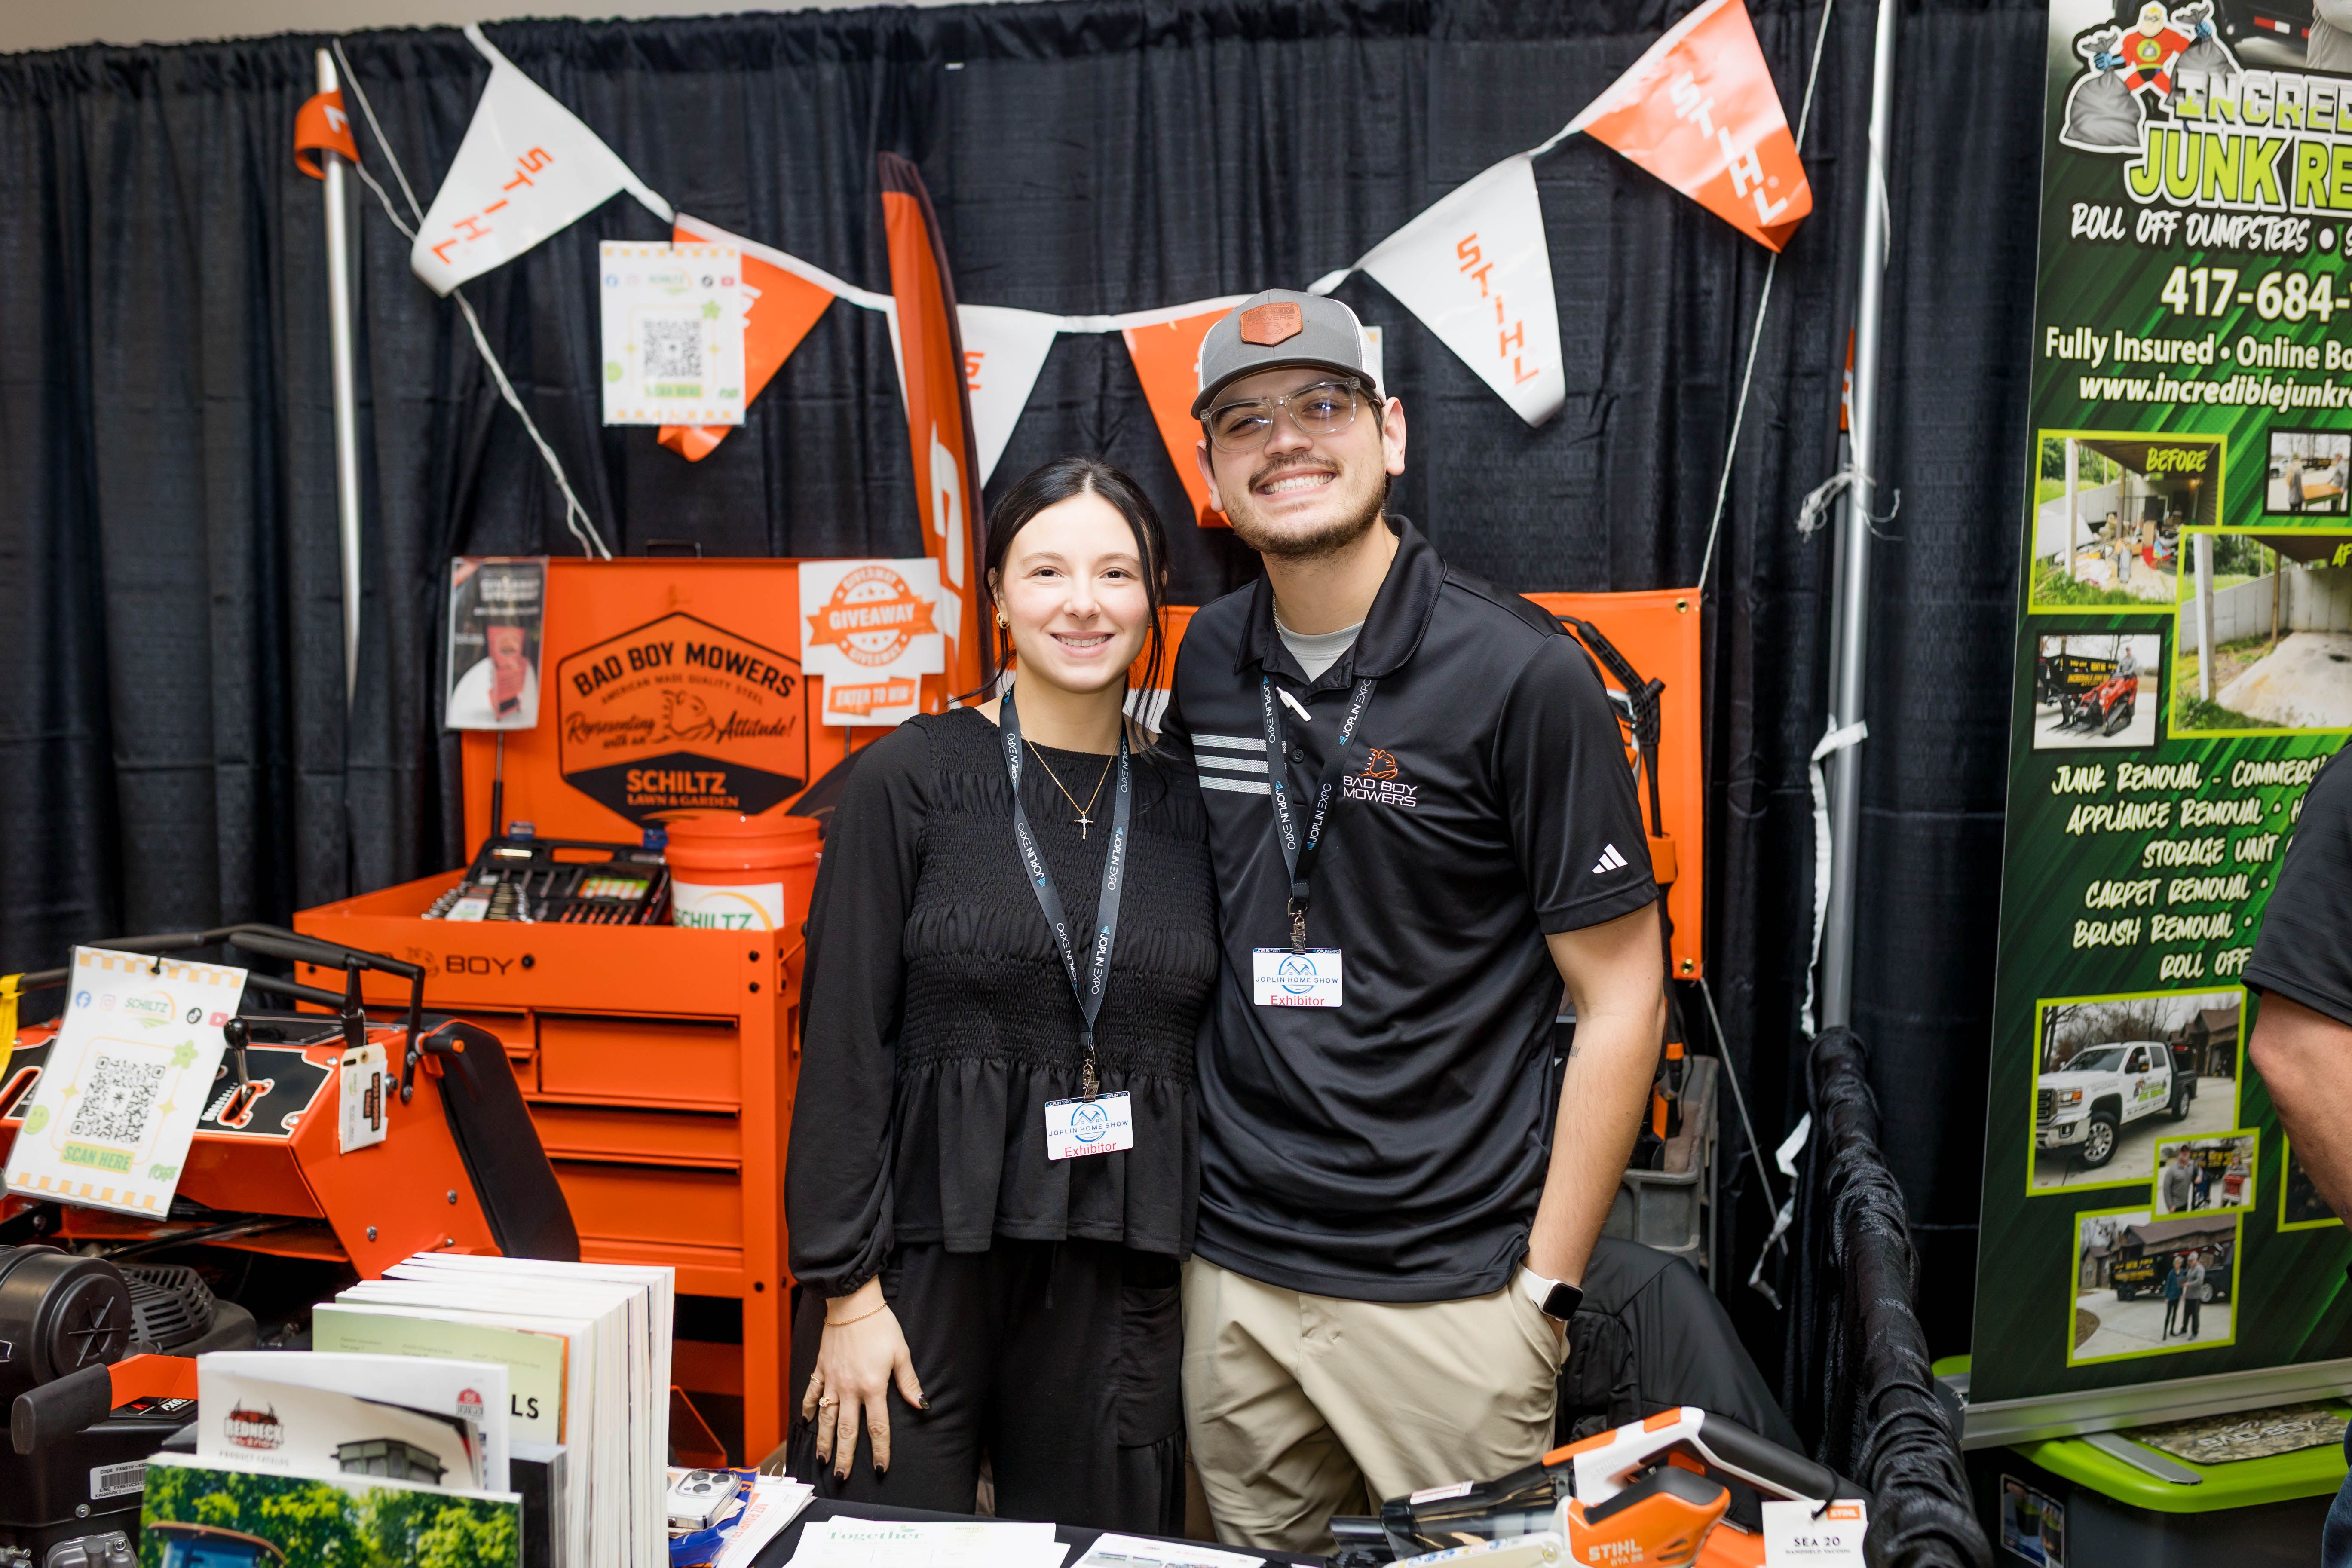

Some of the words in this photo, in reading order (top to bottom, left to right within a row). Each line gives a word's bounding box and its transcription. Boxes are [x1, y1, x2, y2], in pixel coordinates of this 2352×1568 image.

[1668, 72, 1788, 226] STIHL
[2129, 128, 2287, 205] JUNK
[430, 147, 555, 265] STIHL
[2071, 202, 2126, 240] ROLL
[2136, 209, 2183, 245] OFF
[2186, 213, 2310, 252] DUMPSTERS
[2161, 266, 2352, 322] 417-684-
[1246, 310, 1267, 321] BAD
[1247, 315, 1294, 327] MOWERS
[1456, 233, 1539, 386] STIHL
[2046, 326, 2108, 368] Fully
[2114, 330, 2214, 365] Insured
[2236, 336, 2320, 369] Online
[2146, 447, 2208, 472] BEFORE
[829, 603, 915, 630] GIVEAWAY
[573, 655, 623, 698] BAD
[627, 641, 674, 672] BOY
[685, 642, 796, 698] MOWERS
[601, 678, 651, 705] AMERICAN
[655, 673, 684, 684] MADE
[688, 674, 732, 689] QUALITY
[836, 689, 871, 707] ENTER
[873, 688, 886, 704] TO
[1263, 685, 1273, 717] JOPLIN
[1342, 704, 1362, 738] JOPLIN
[1356, 678, 1372, 704] EXPO
[715, 710, 796, 745] Attitude!
[1266, 717, 1276, 744] EXPO
[1007, 733, 1017, 754] EXPO
[626, 769, 726, 795] SCHILTZ
[1008, 754, 1018, 785] JOPLIN
[2052, 765, 2106, 795] JUNK
[2117, 761, 2202, 792] REMOVAL
[1343, 775, 1375, 789] BAD
[1381, 780, 1418, 796] BOY
[1344, 787, 1417, 808] MOWERS
[627, 794, 666, 806] LAWN
[680, 796, 739, 808] GARDEN
[1309, 810, 1325, 843] JOPLIN
[1317, 783, 1332, 811] EXPO
[2180, 797, 2264, 828] REMOVAL
[1275, 790, 1290, 823] JOPLIN
[1283, 824, 1296, 850] EXPO
[1018, 822, 1032, 848] EXPO
[1026, 846, 1045, 878] JOPLIN
[1112, 834, 1122, 865] JOPLIN
[2142, 837, 2226, 869] STORAGE
[1107, 865, 1118, 890] EXPO
[2085, 878, 2162, 909] CARPET
[2168, 874, 2251, 906] REMOVAL
[1057, 923, 1070, 949] EXPO
[2073, 916, 2141, 948] BRUSH
[2151, 912, 2234, 943] REMOVAL
[1095, 933, 1109, 967] JOPLIN
[446, 955, 514, 975] BOY
[1066, 950, 1077, 983] JOPLIN
[2160, 952, 2205, 981] ROLL
[2214, 947, 2253, 976] OFF
[1091, 968, 1103, 995] EXPO
[125, 997, 168, 1013] SCHILTZ
[1271, 995, 1325, 1006] Exhibitor
[1049, 1127, 1077, 1136] JOPLIN
[1106, 1120, 1129, 1128] SHOW
[63, 1145, 96, 1162] SCAN
[98, 1152, 132, 1172] HERE
[1065, 1142, 1117, 1157] Exhibitor
[226, 1418, 282, 1444] REDNECK
[2197, 1432, 2260, 1447] BAD
[2261, 1420, 2318, 1436] BOY
[1830, 1509, 1858, 1517] STIHL
[1589, 1538, 1643, 1562] STIHL
[1794, 1537, 1818, 1547] SEA
[1825, 1537, 1841, 1547] 20
